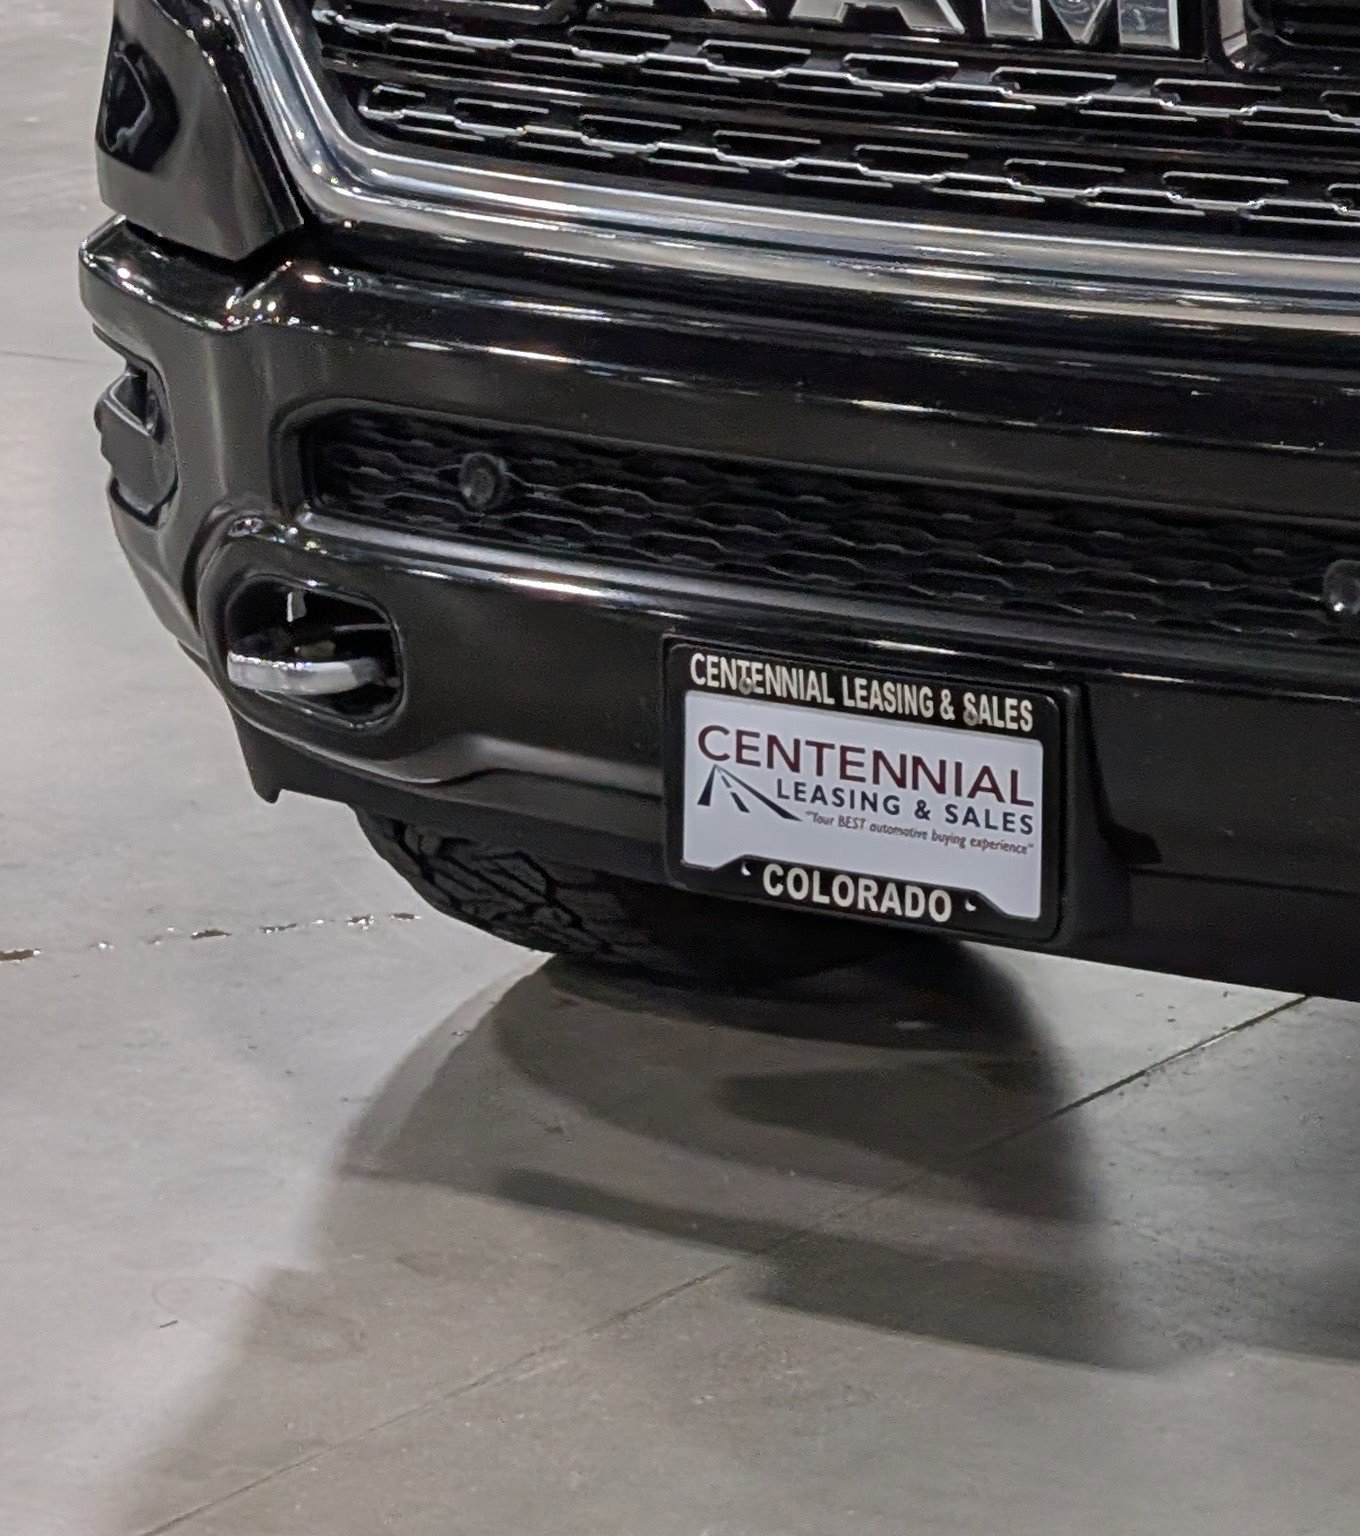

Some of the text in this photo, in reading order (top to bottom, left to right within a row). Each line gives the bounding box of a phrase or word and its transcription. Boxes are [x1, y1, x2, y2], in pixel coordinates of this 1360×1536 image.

[690, 651, 1034, 732] CENTENNIAL LEASING & SALES
[698, 724, 1035, 807] CENTENNIAL
[777, 778, 1034, 835] LEASING & SALES
[838, 814, 866, 830] BEST
[869, 822, 928, 840] automotive
[931, 829, 966, 849] buying
[762, 863, 953, 923] COLORADO
